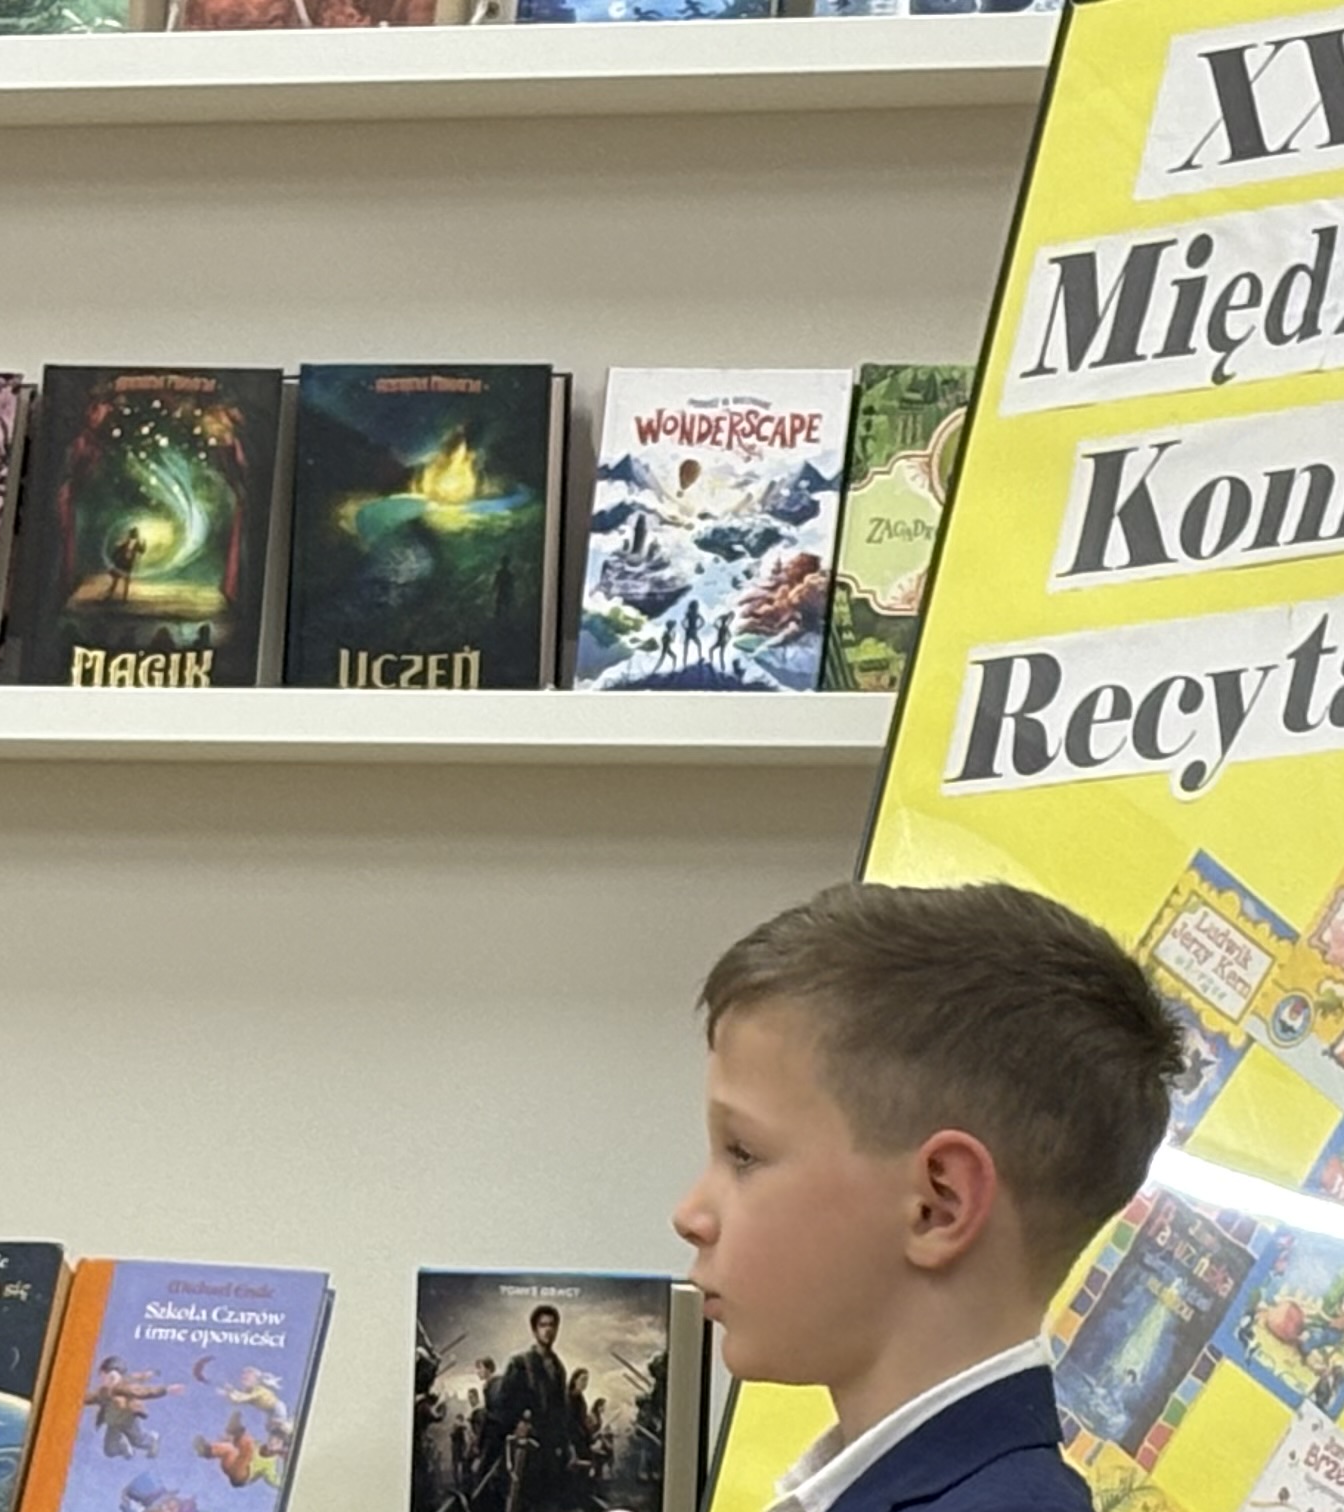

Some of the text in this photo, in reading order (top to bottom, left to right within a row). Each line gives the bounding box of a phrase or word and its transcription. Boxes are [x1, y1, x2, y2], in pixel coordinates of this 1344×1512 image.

[634, 408, 824, 452] WONDERSCAPE
[71, 645, 214, 688] MAGIK
[338, 645, 482, 690] UCZEŃ
[1170, 921, 1254, 1001] Jerzy Kern
[1194, 909, 1256, 971] Ludwik
[2, 1281, 33, 1301] się
[143, 1301, 287, 1327] Szkoła Czarów
[145, 1325, 189, 1345] inne
[190, 1326, 287, 1352] opowieści
